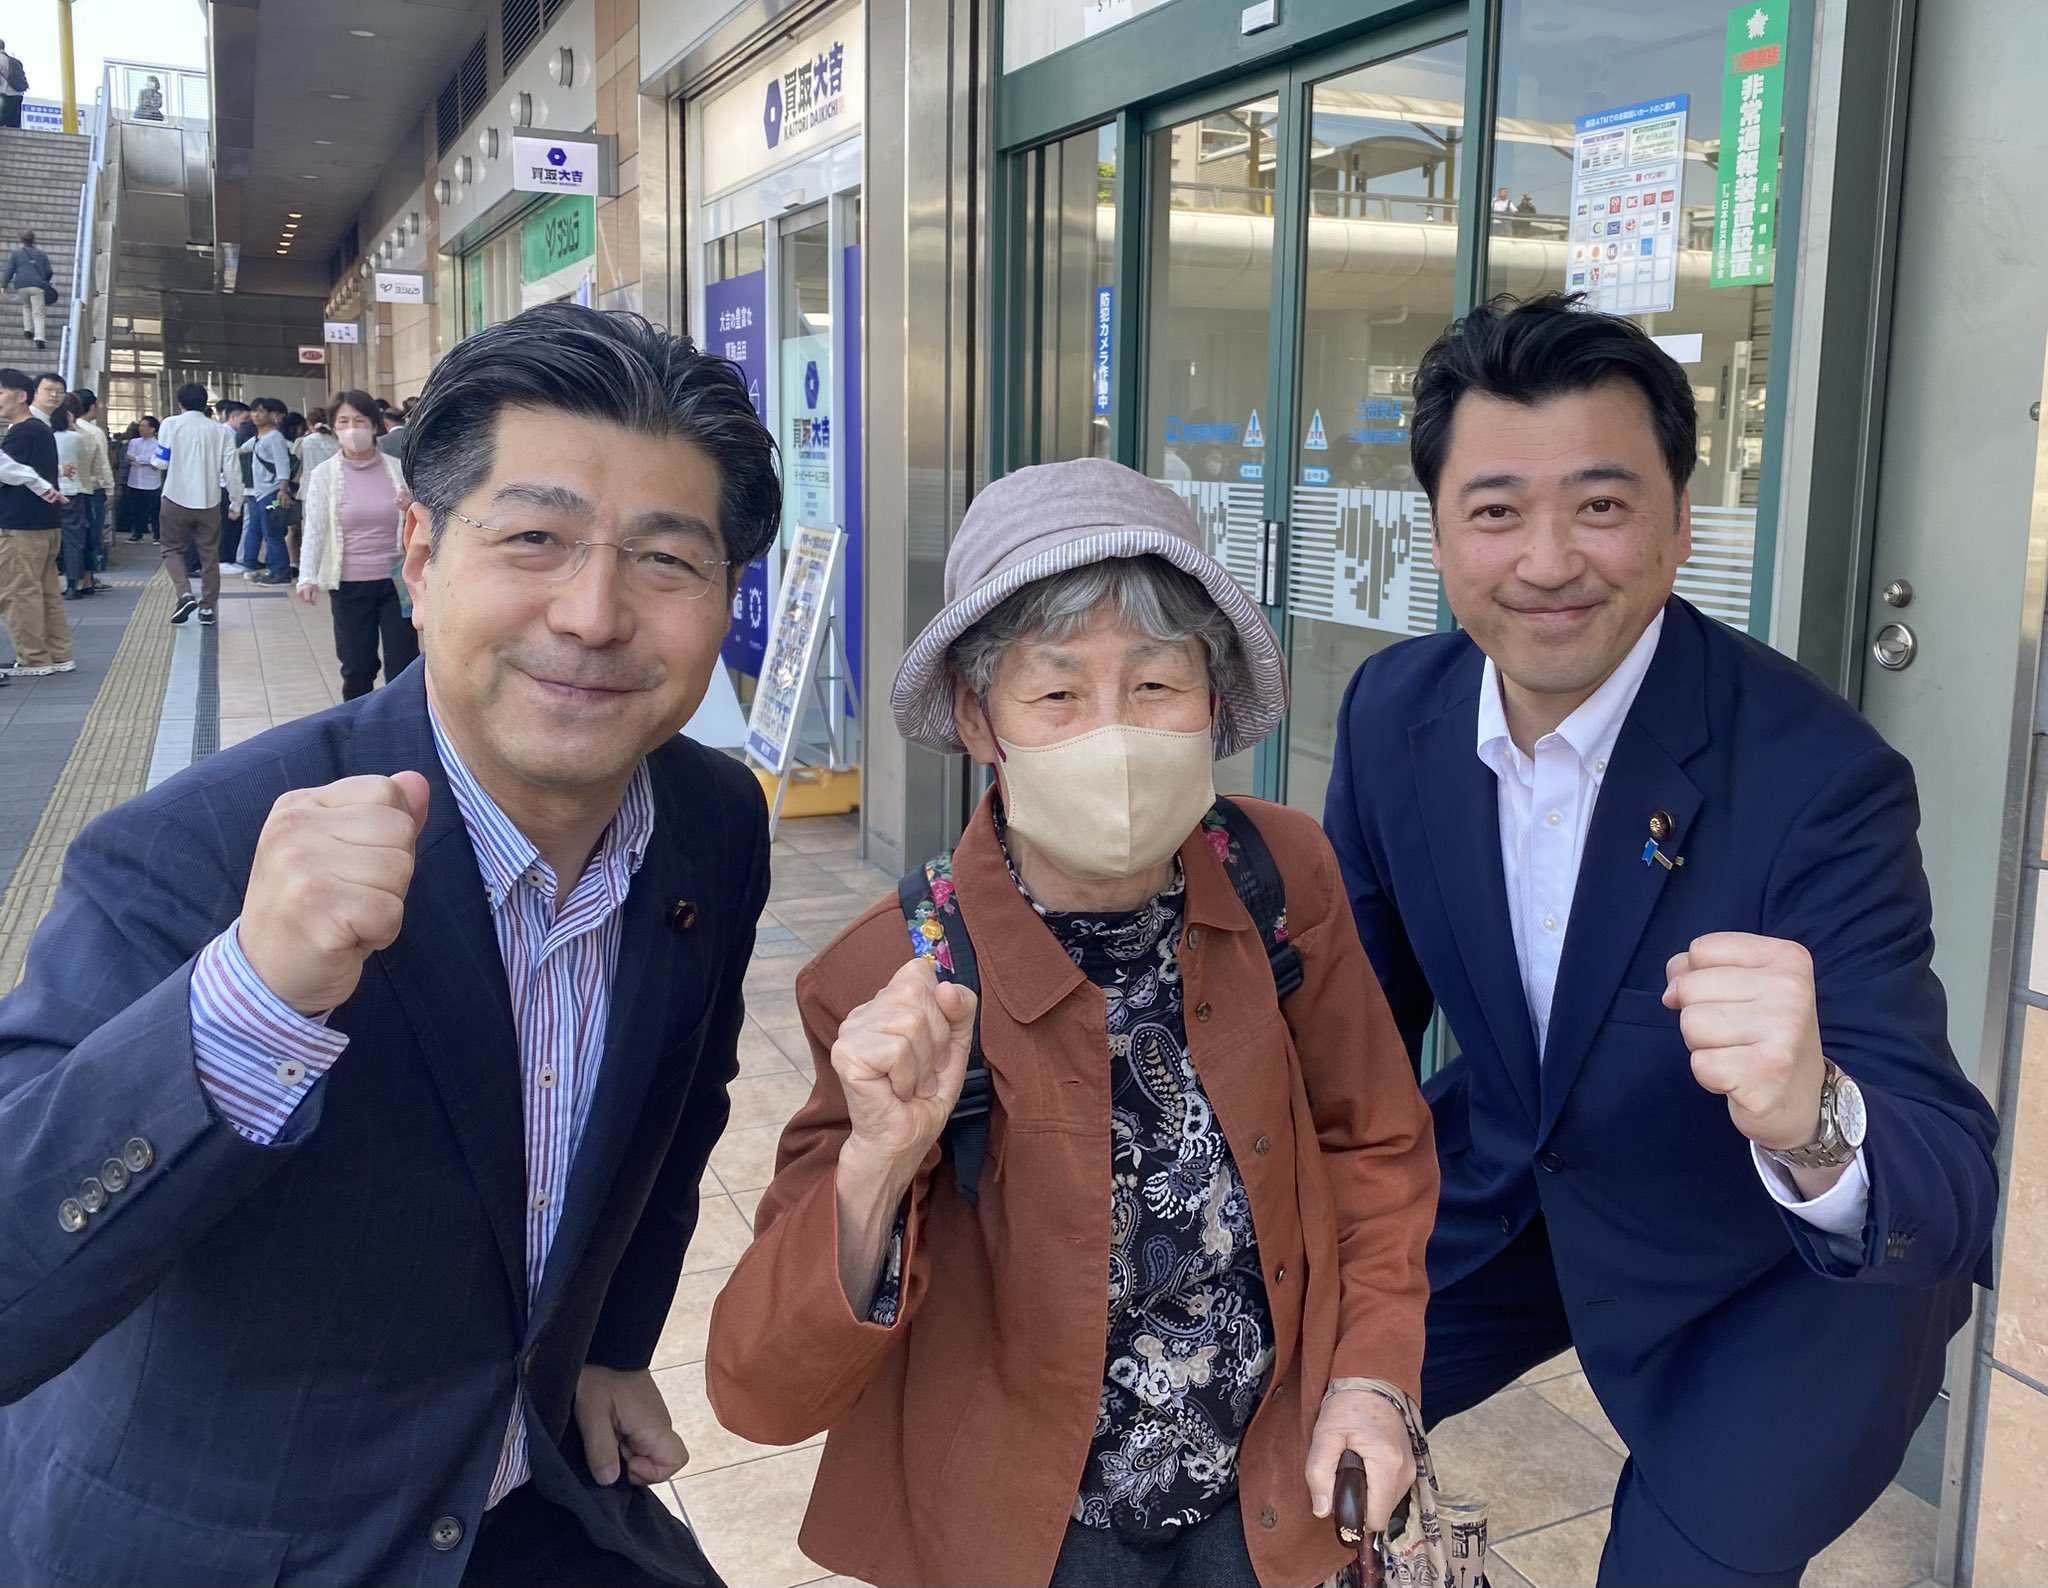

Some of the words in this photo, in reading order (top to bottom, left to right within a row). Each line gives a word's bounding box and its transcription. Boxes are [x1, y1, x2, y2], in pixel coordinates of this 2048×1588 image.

[784, 41, 844, 123] 買取大吉
[784, 114, 808, 141] KAITORI
[810, 98, 838, 128] DAIKICHI
[531, 167, 583, 182] 買取大吉
[1730, 73, 1764, 277] 非常通報装置設置
[719, 306, 752, 332] 大吉の豊富な
[1098, 292, 1110, 409] 防犯カメラ作動中
[793, 416, 829, 449] 買取大吉
